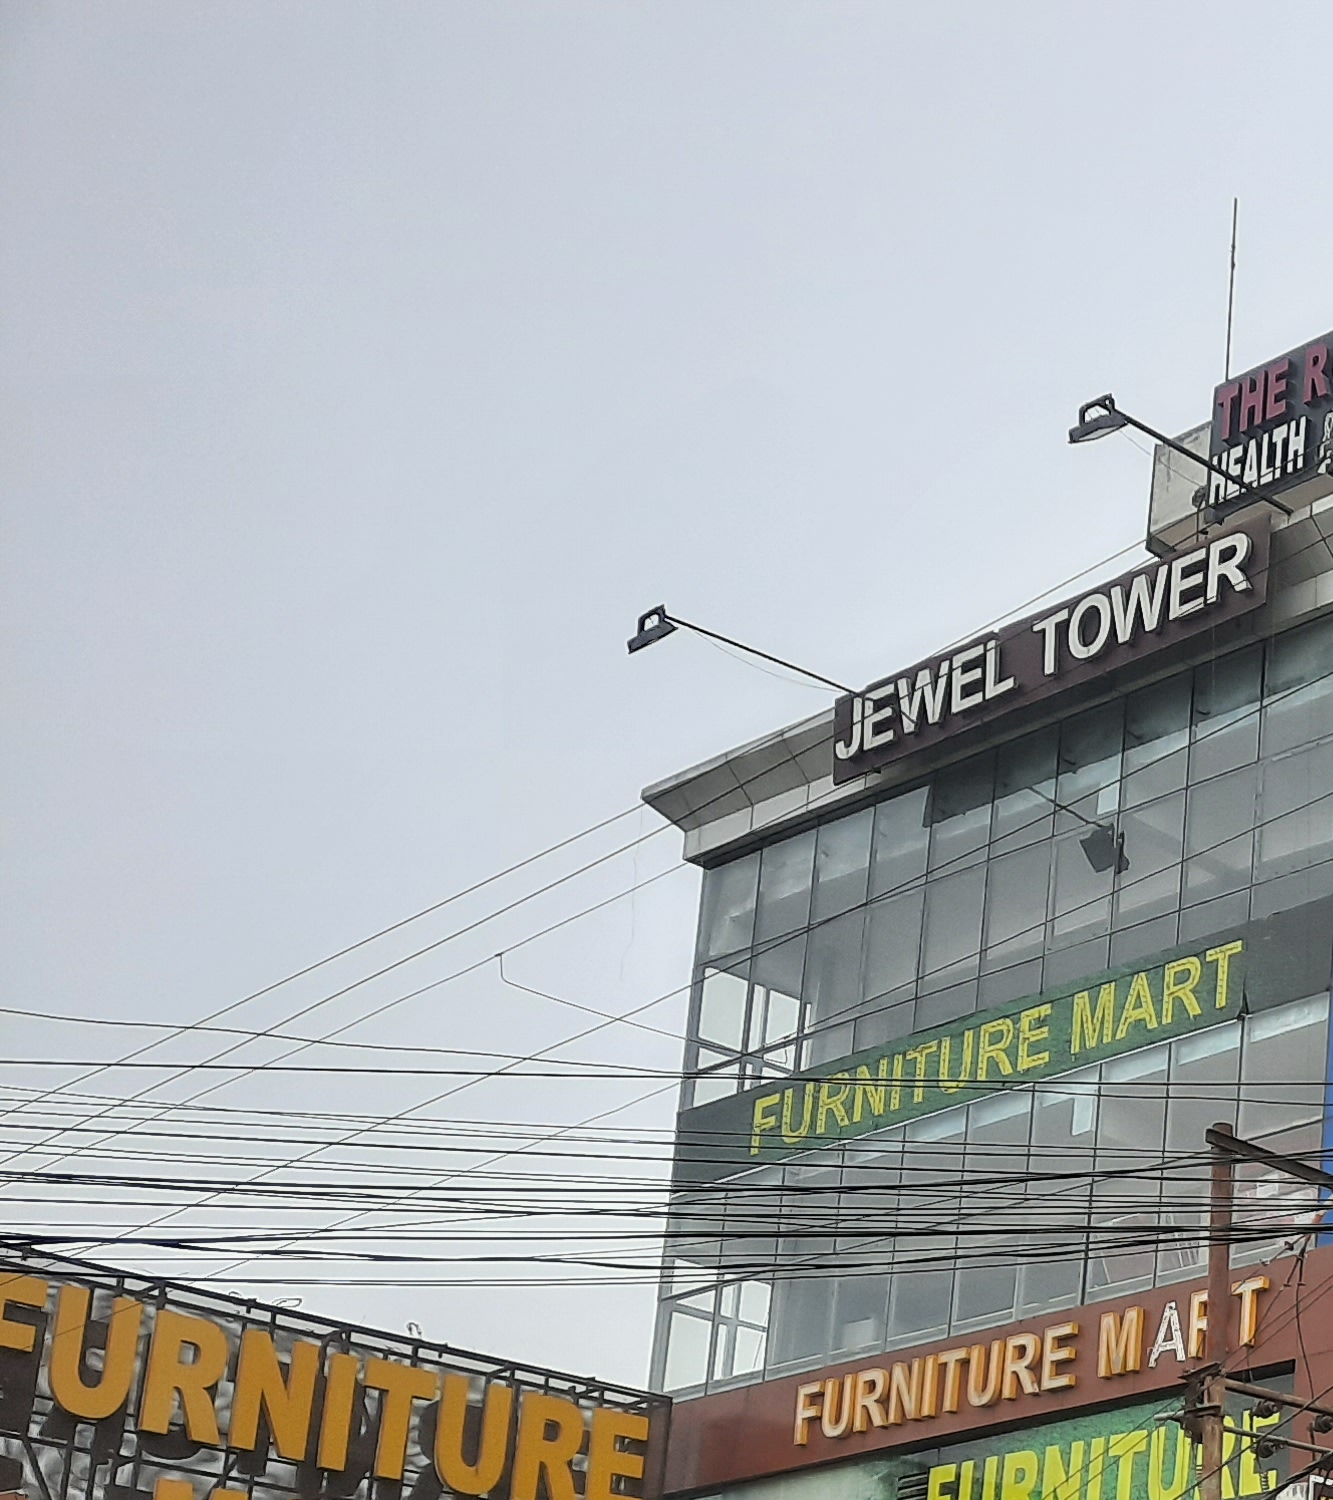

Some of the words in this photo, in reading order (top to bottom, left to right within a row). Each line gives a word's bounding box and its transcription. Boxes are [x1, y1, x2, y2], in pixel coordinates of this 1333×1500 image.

[1209, 416, 1307, 506] HEALTH
[1216, 358, 1291, 443] THE
[834, 638, 1017, 763] JEWEL
[1033, 531, 1254, 677] TOWER
[750, 1002, 1053, 1156] FURNITURE
[1070, 939, 1244, 1054] MART
[793, 1320, 1080, 1447] FURNITURE
